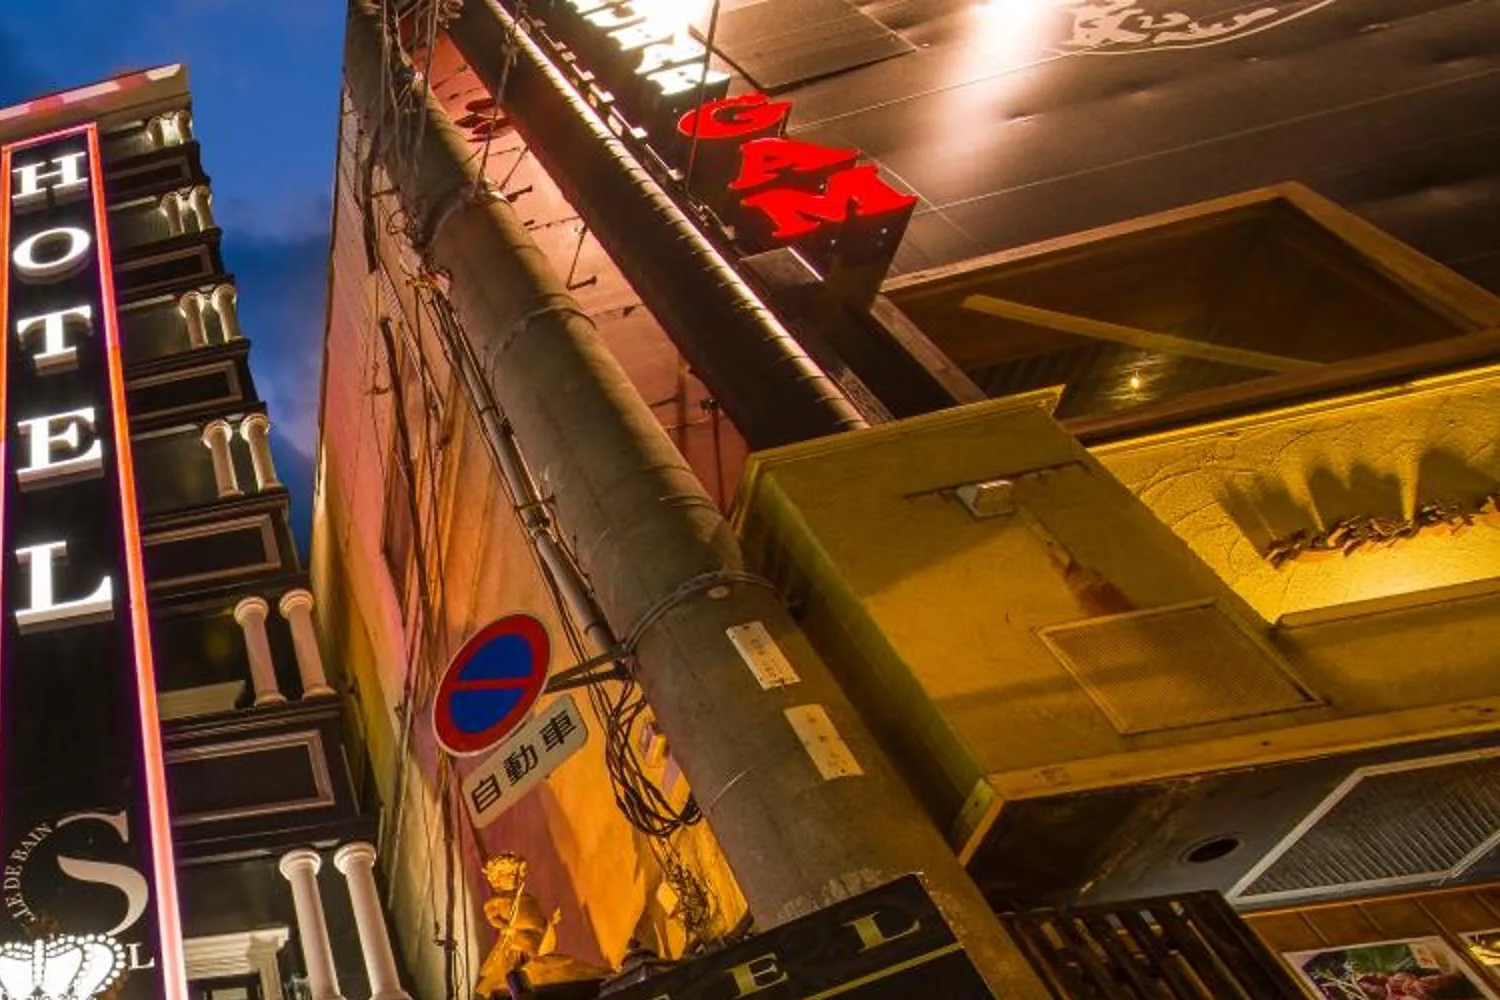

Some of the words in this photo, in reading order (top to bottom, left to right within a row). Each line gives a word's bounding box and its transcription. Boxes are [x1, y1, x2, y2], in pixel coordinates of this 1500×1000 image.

[11, 150, 113, 629] HOTEL
[470, 707, 577, 816] 自動車
[4, 865, 23, 890] DE
[9, 822, 53, 862] BAIN
